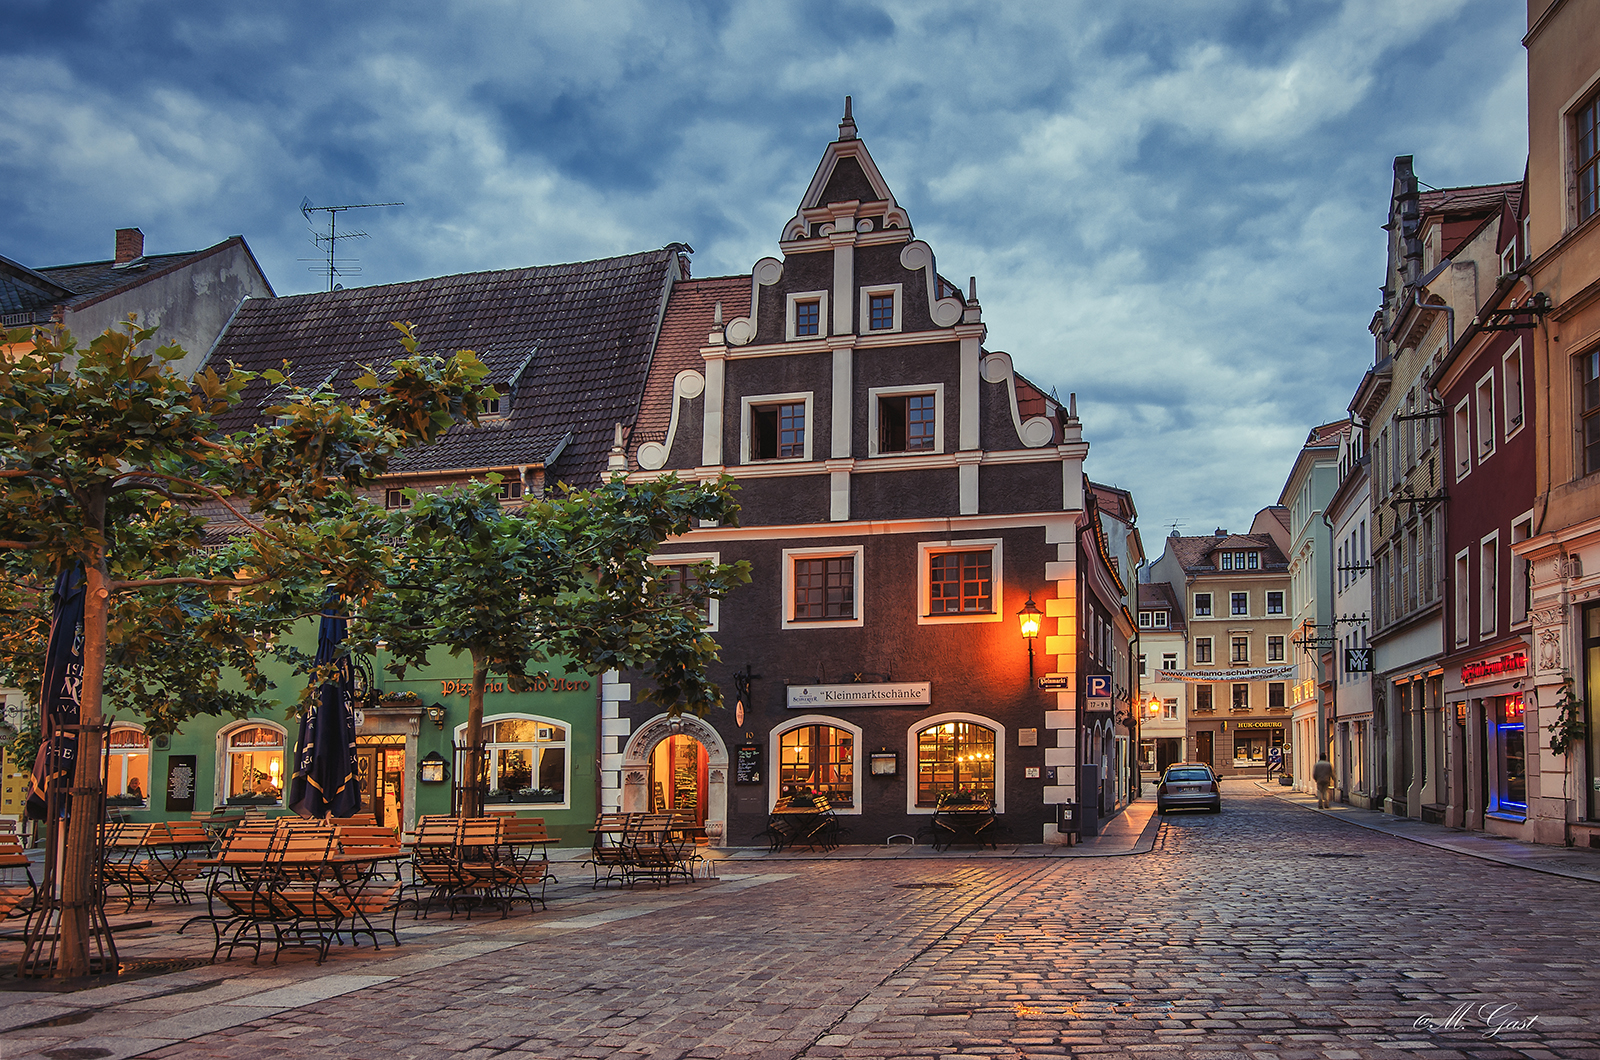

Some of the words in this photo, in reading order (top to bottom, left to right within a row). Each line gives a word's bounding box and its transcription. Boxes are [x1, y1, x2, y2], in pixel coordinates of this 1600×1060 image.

[1160, 667, 1292, 677] www.andiamo-schuhmode.de
[440, 678, 503, 697] Pizzria
[550, 677, 590, 692] Nero
[1092, 678, 1106, 695] P
[745, 731, 754, 739] 10
